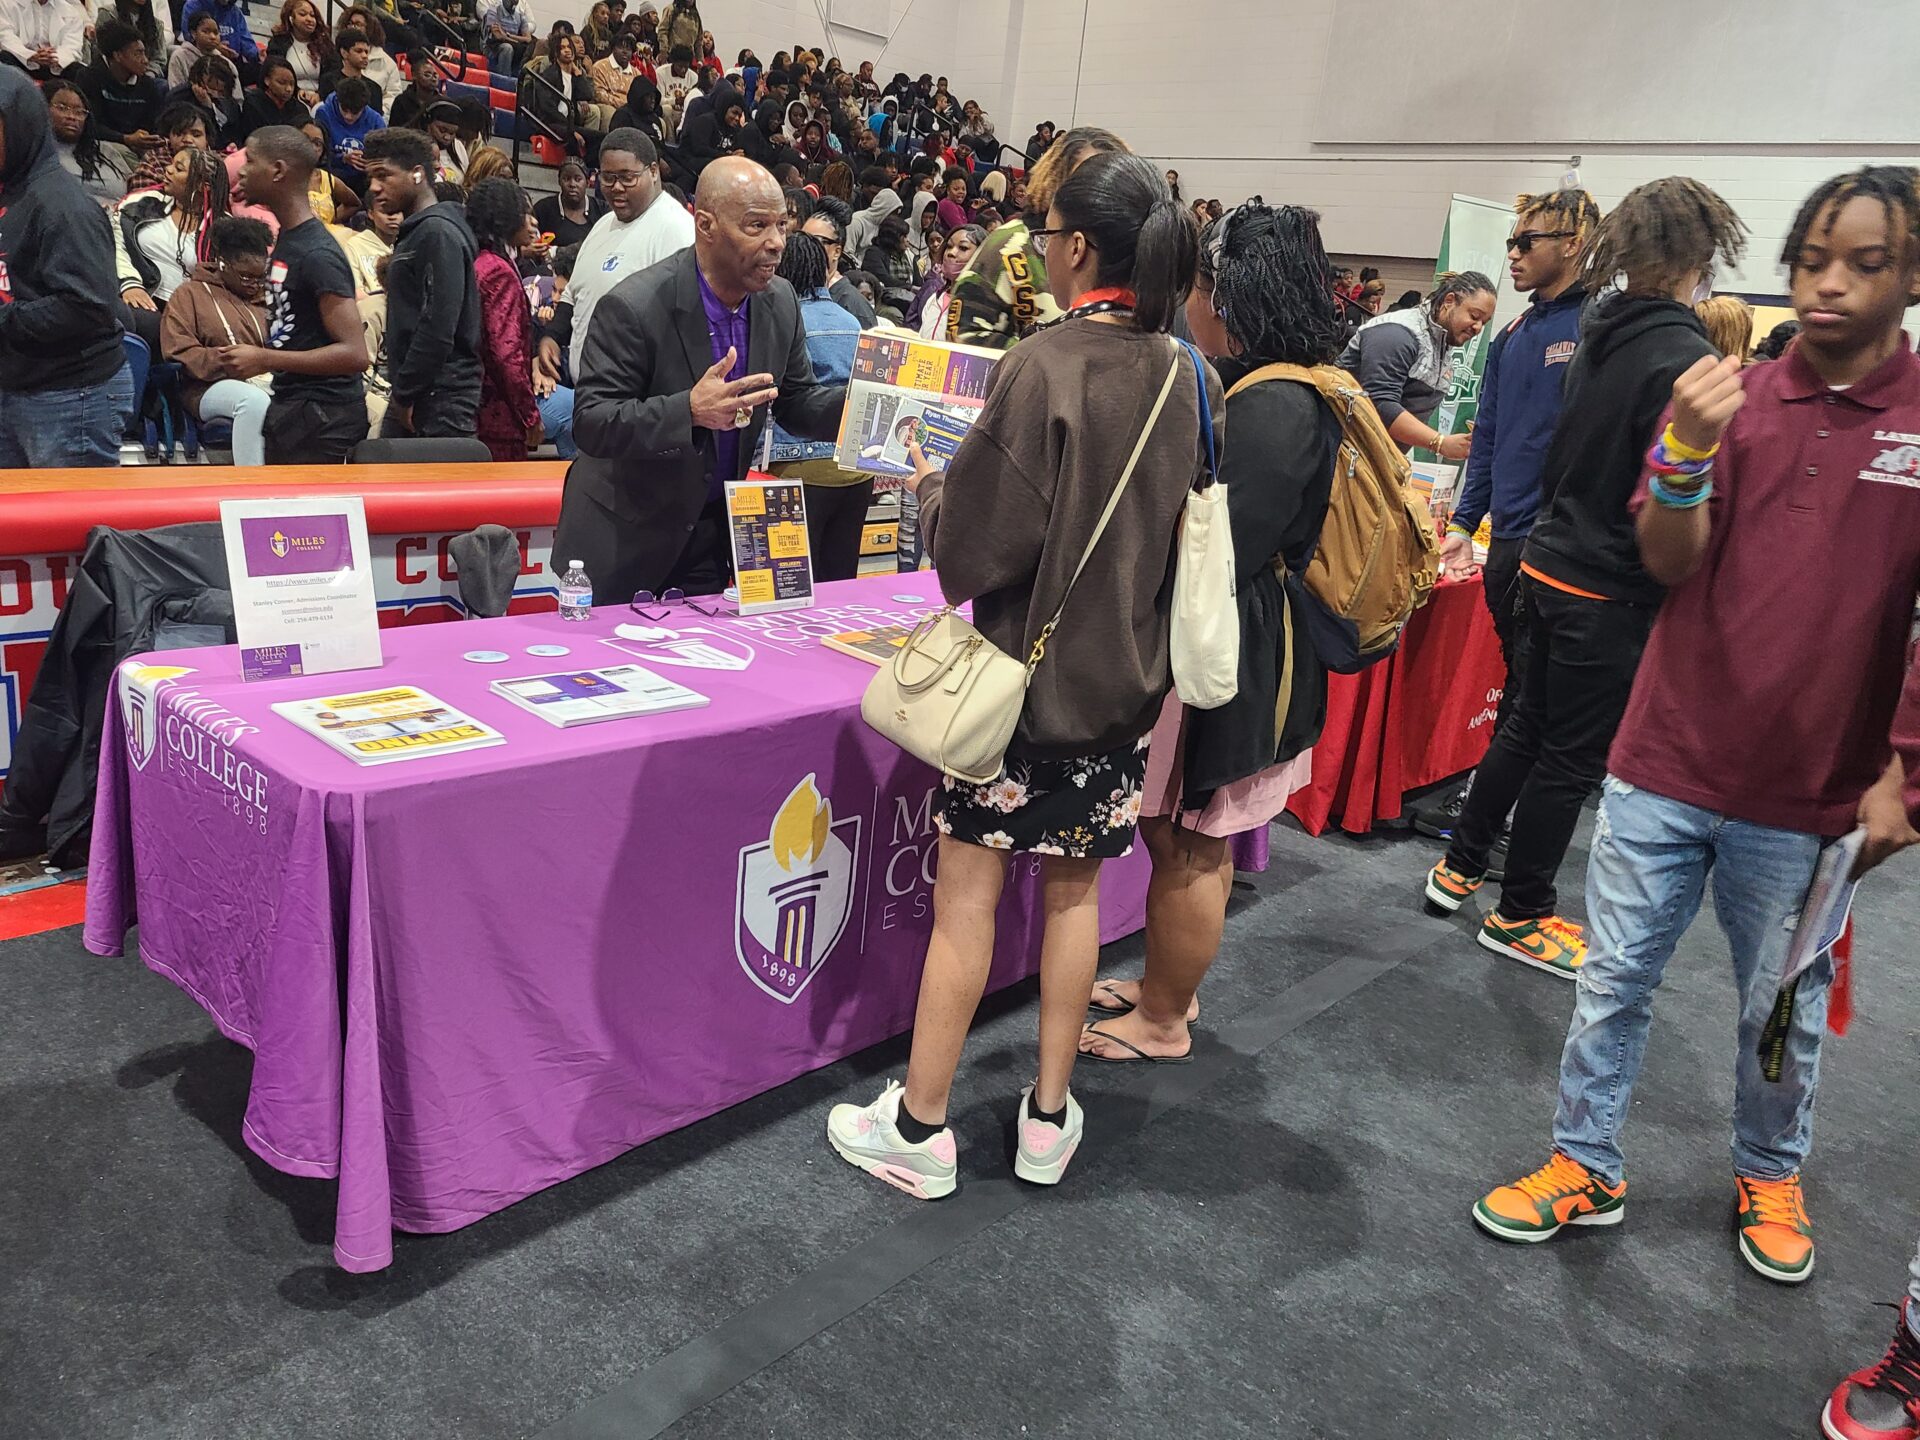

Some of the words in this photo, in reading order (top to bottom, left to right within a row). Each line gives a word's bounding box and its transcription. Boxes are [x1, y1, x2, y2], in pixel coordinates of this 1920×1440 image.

[914, 359, 926, 387] TIMATE
[925, 409, 941, 419] Ryan
[942, 415, 968, 428] Thurman
[291, 536, 326, 546] MILES
[266, 576, 336, 588] https://www.miles.ed
[730, 604, 883, 631] MILES
[255, 646, 287, 657] MILES
[167, 691, 261, 747] MILES
[353, 725, 486, 752] ONLINE
[166, 715, 268, 813] COLLEGE
[222, 788, 267, 835] 1898
[1009, 853, 1042, 883] 18
[761, 953, 797, 987] 1898
